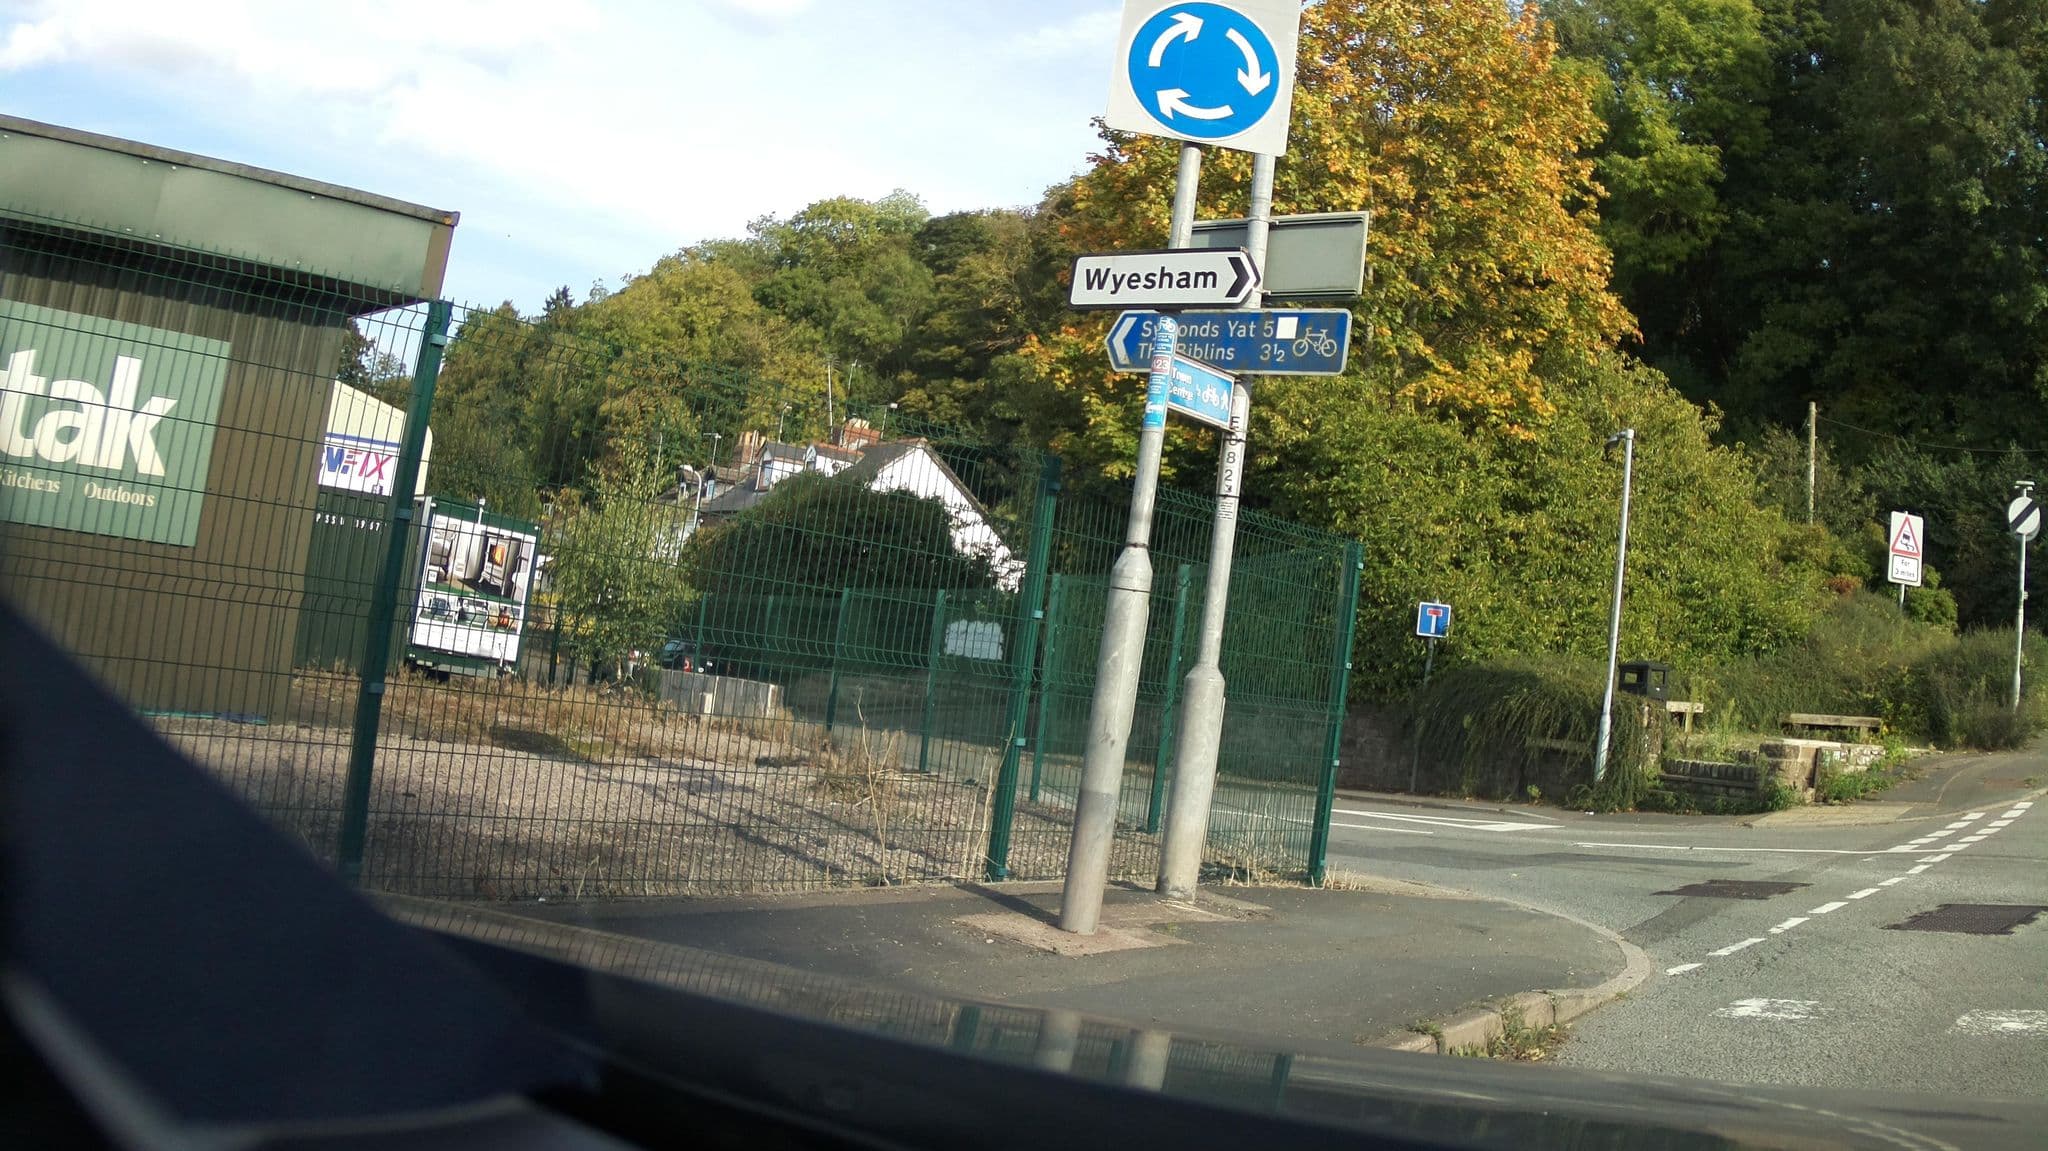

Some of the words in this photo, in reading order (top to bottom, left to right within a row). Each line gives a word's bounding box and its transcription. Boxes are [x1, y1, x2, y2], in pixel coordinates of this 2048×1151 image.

[1085, 266, 1218, 295] Wyesham
[1227, 320, 1256, 338] Yat
[1263, 320, 1275, 338] 5
[1138, 343, 1156, 359] Th
[84, 481, 156, 507] Outdoors
